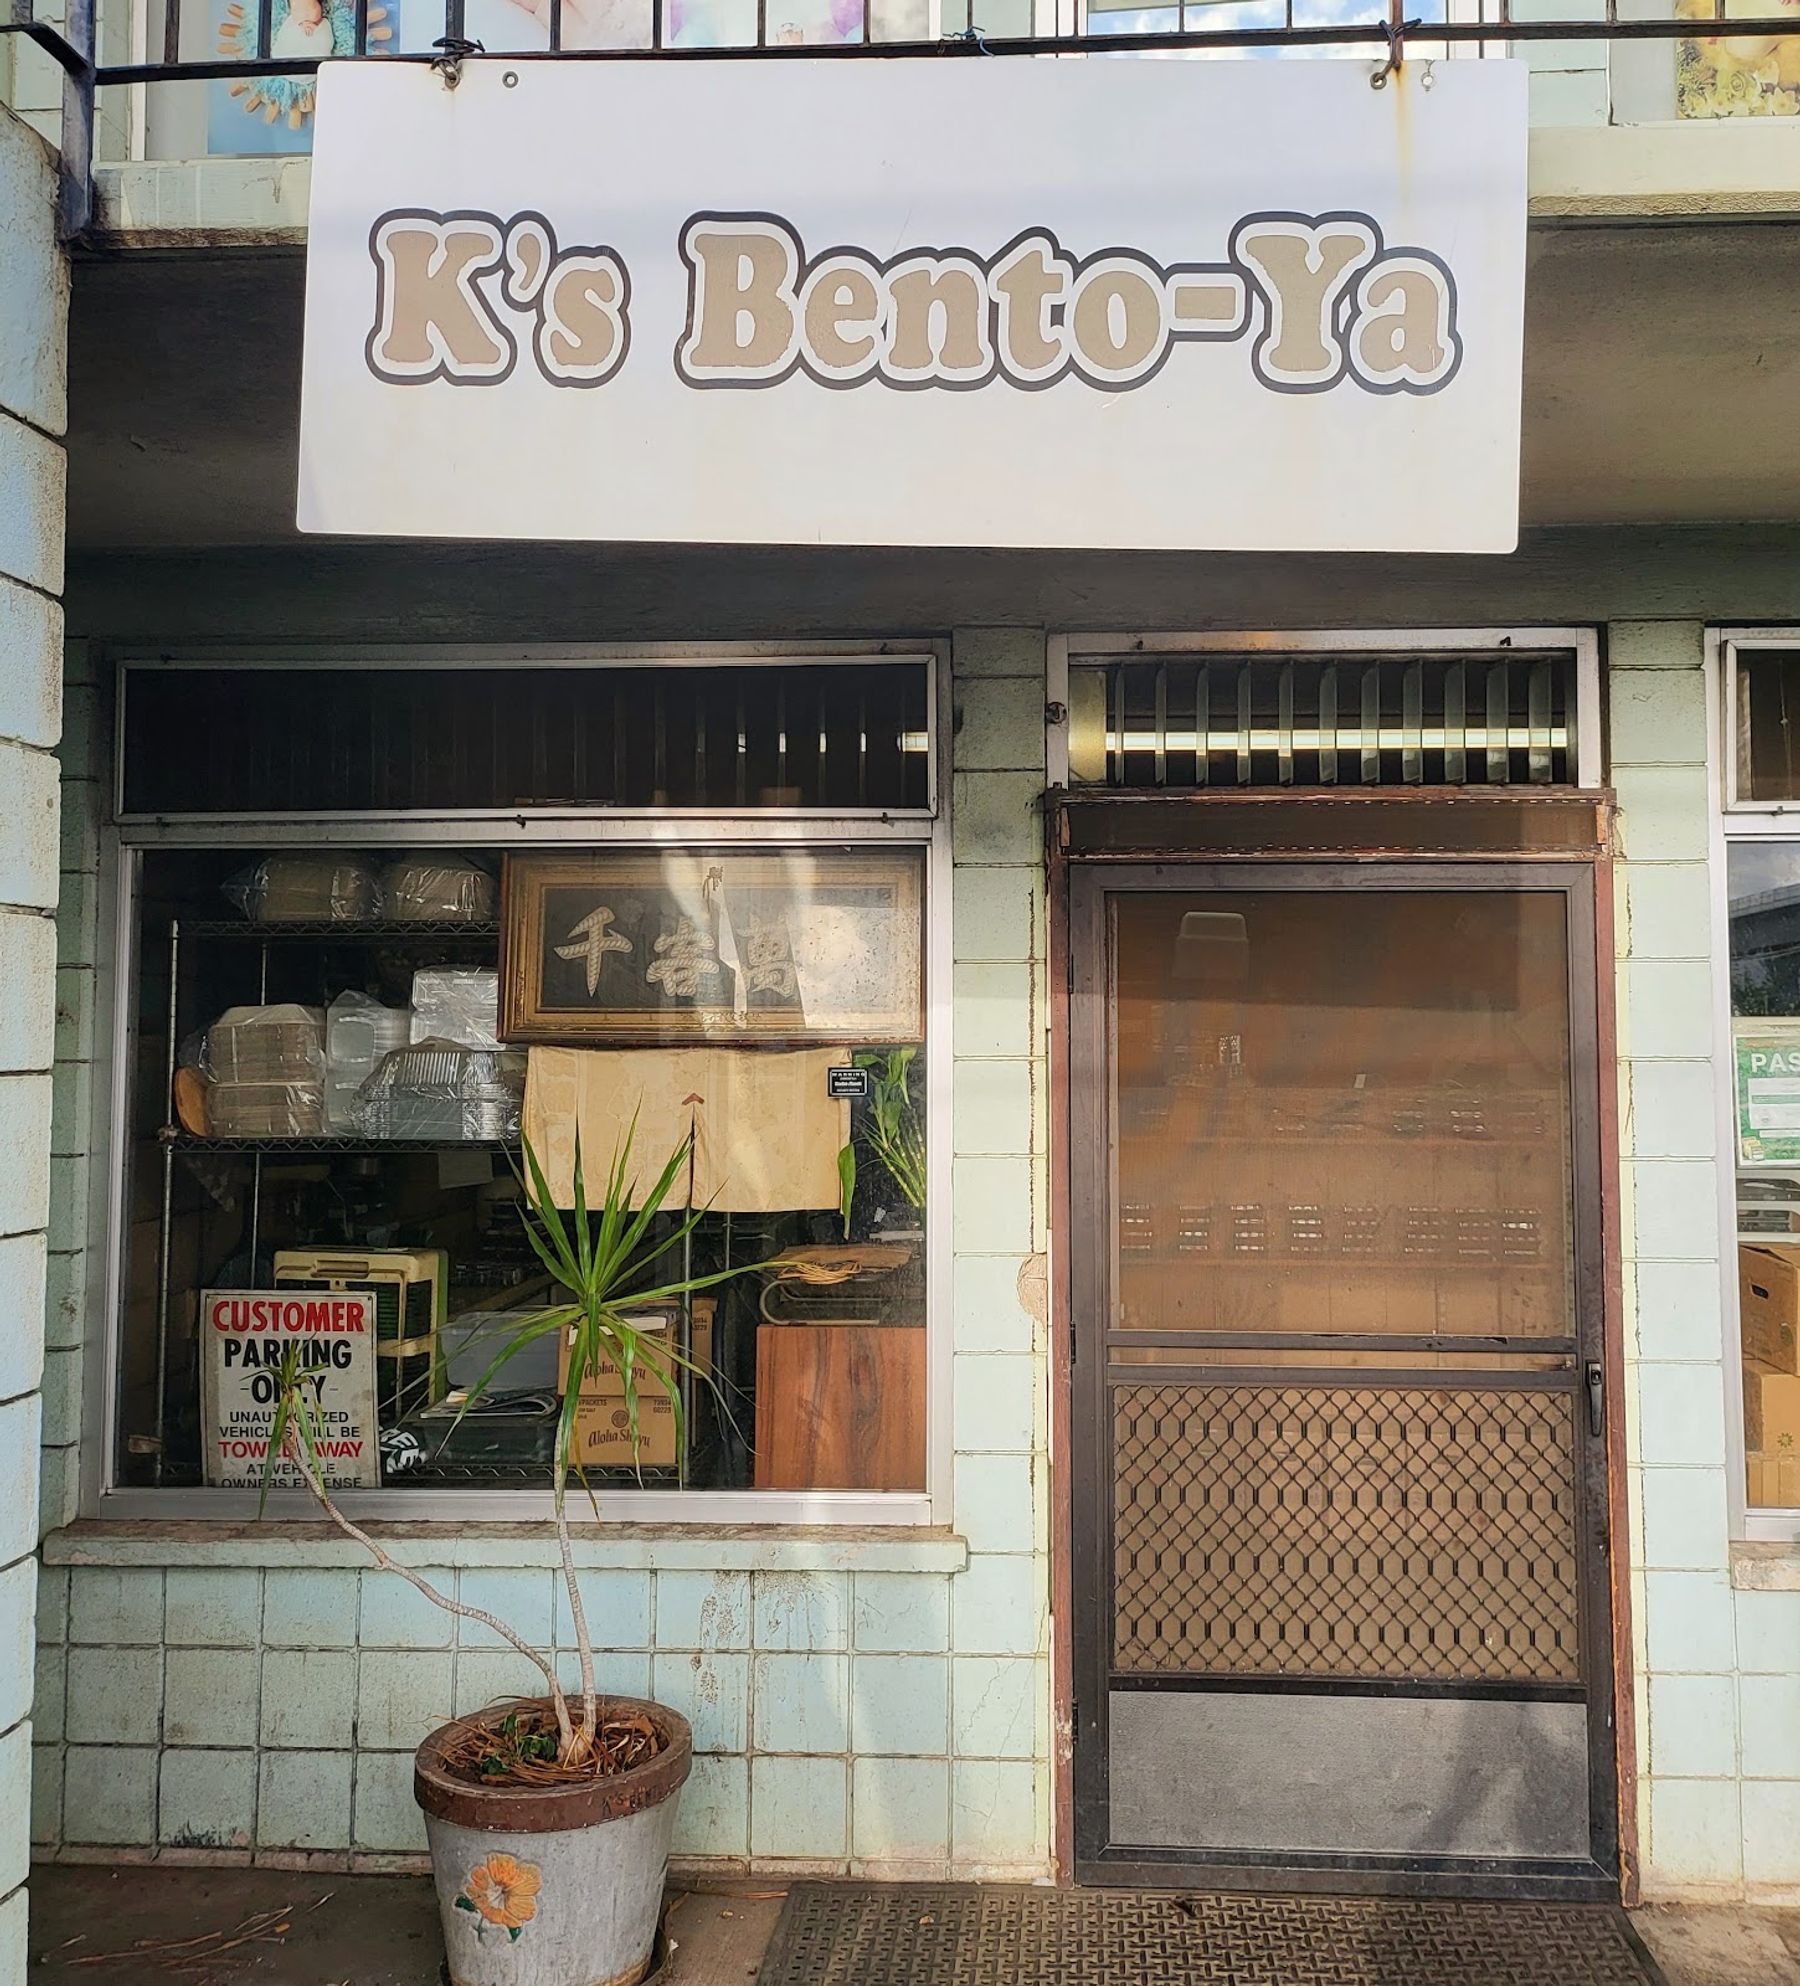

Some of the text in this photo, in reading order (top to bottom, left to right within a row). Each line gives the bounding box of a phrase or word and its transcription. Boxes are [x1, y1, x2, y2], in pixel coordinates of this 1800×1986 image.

[370, 215, 1456, 388] K's Bento-Ya
[212, 1300, 365, 1332] CUSTOMER
[251, 1374, 327, 1404] OY
[219, 1426, 293, 1438] VEHICLS
[340, 1426, 361, 1438] BE
[588, 1428, 651, 1449] Aloha Shyu
[246, 1463, 268, 1475] AT
[293, 1477, 362, 1489] EENSE
